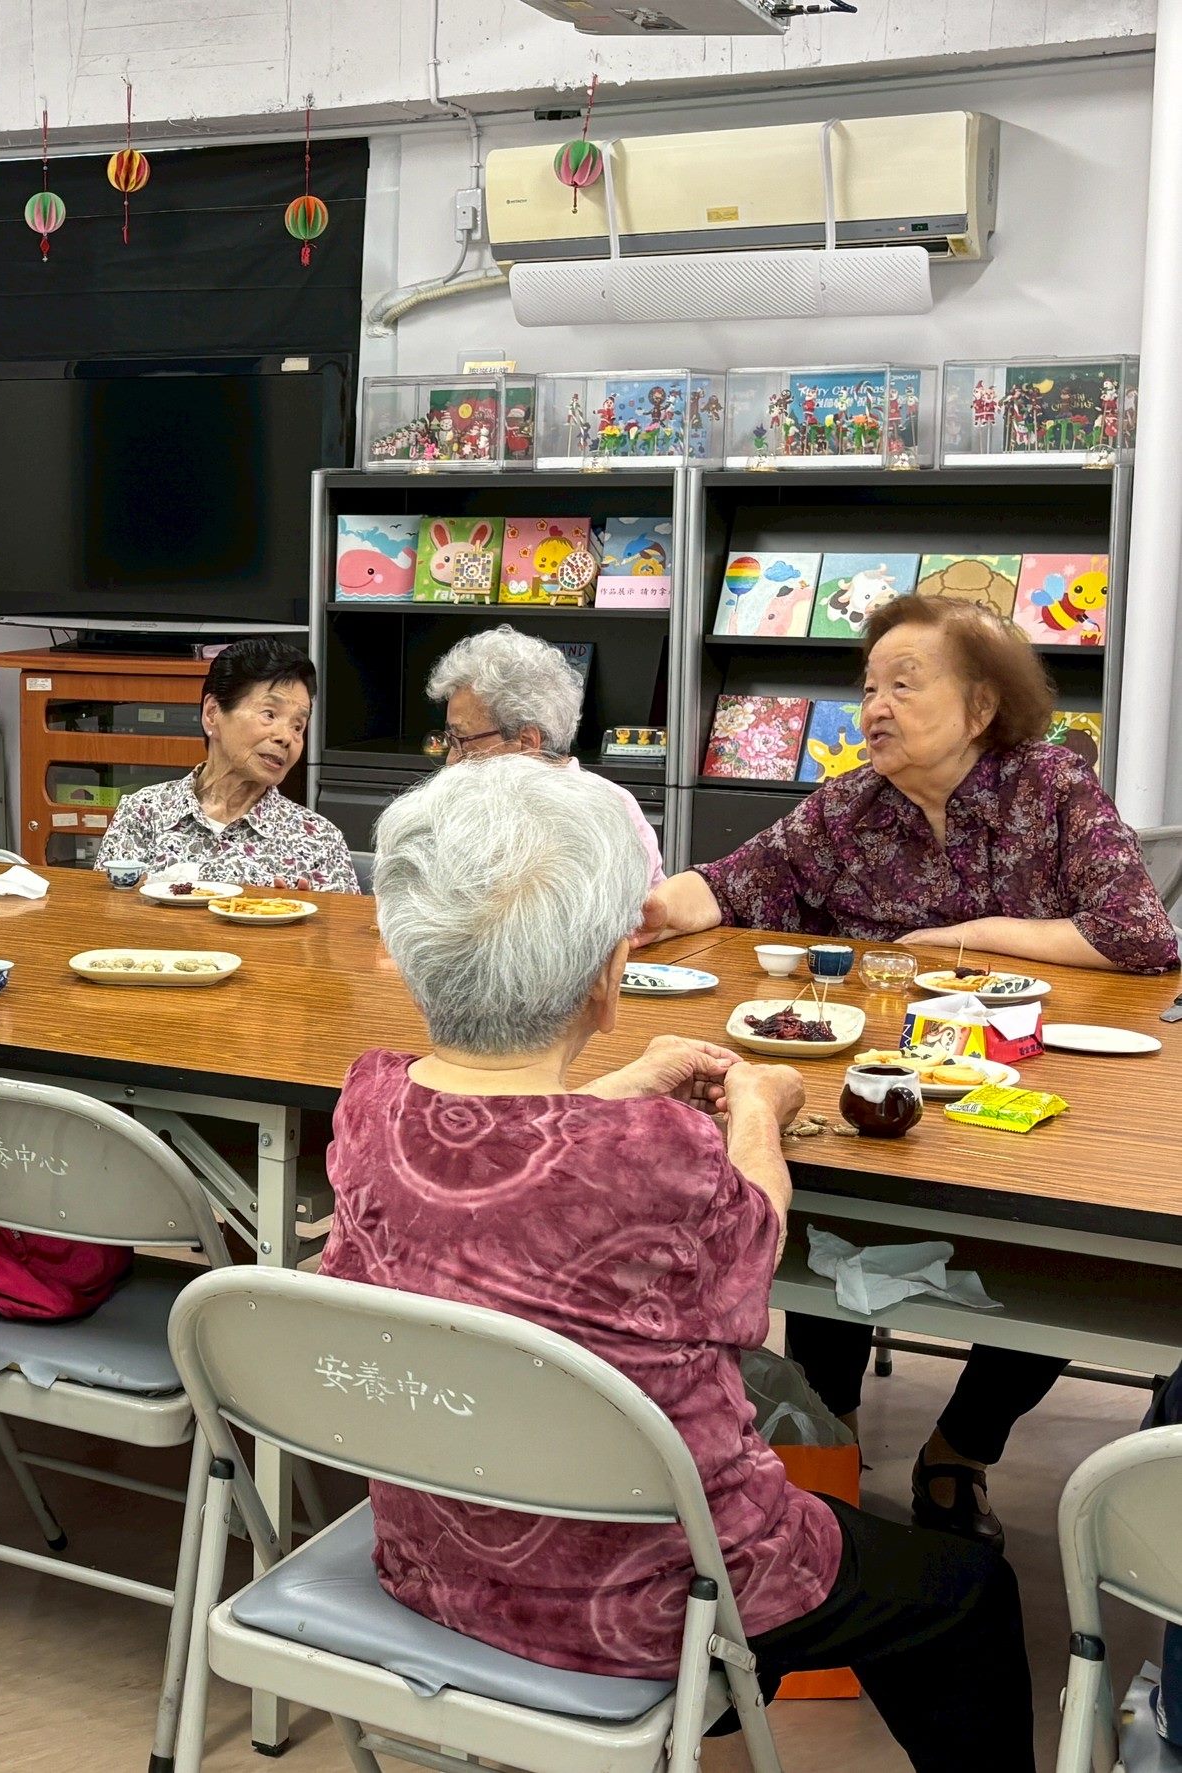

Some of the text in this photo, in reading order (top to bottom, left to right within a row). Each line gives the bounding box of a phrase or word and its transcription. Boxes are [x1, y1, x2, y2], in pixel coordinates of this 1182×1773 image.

[600, 587, 671, 596] 作品展示 請勿拿
[314, 1354, 476, 1416] 安養中心
